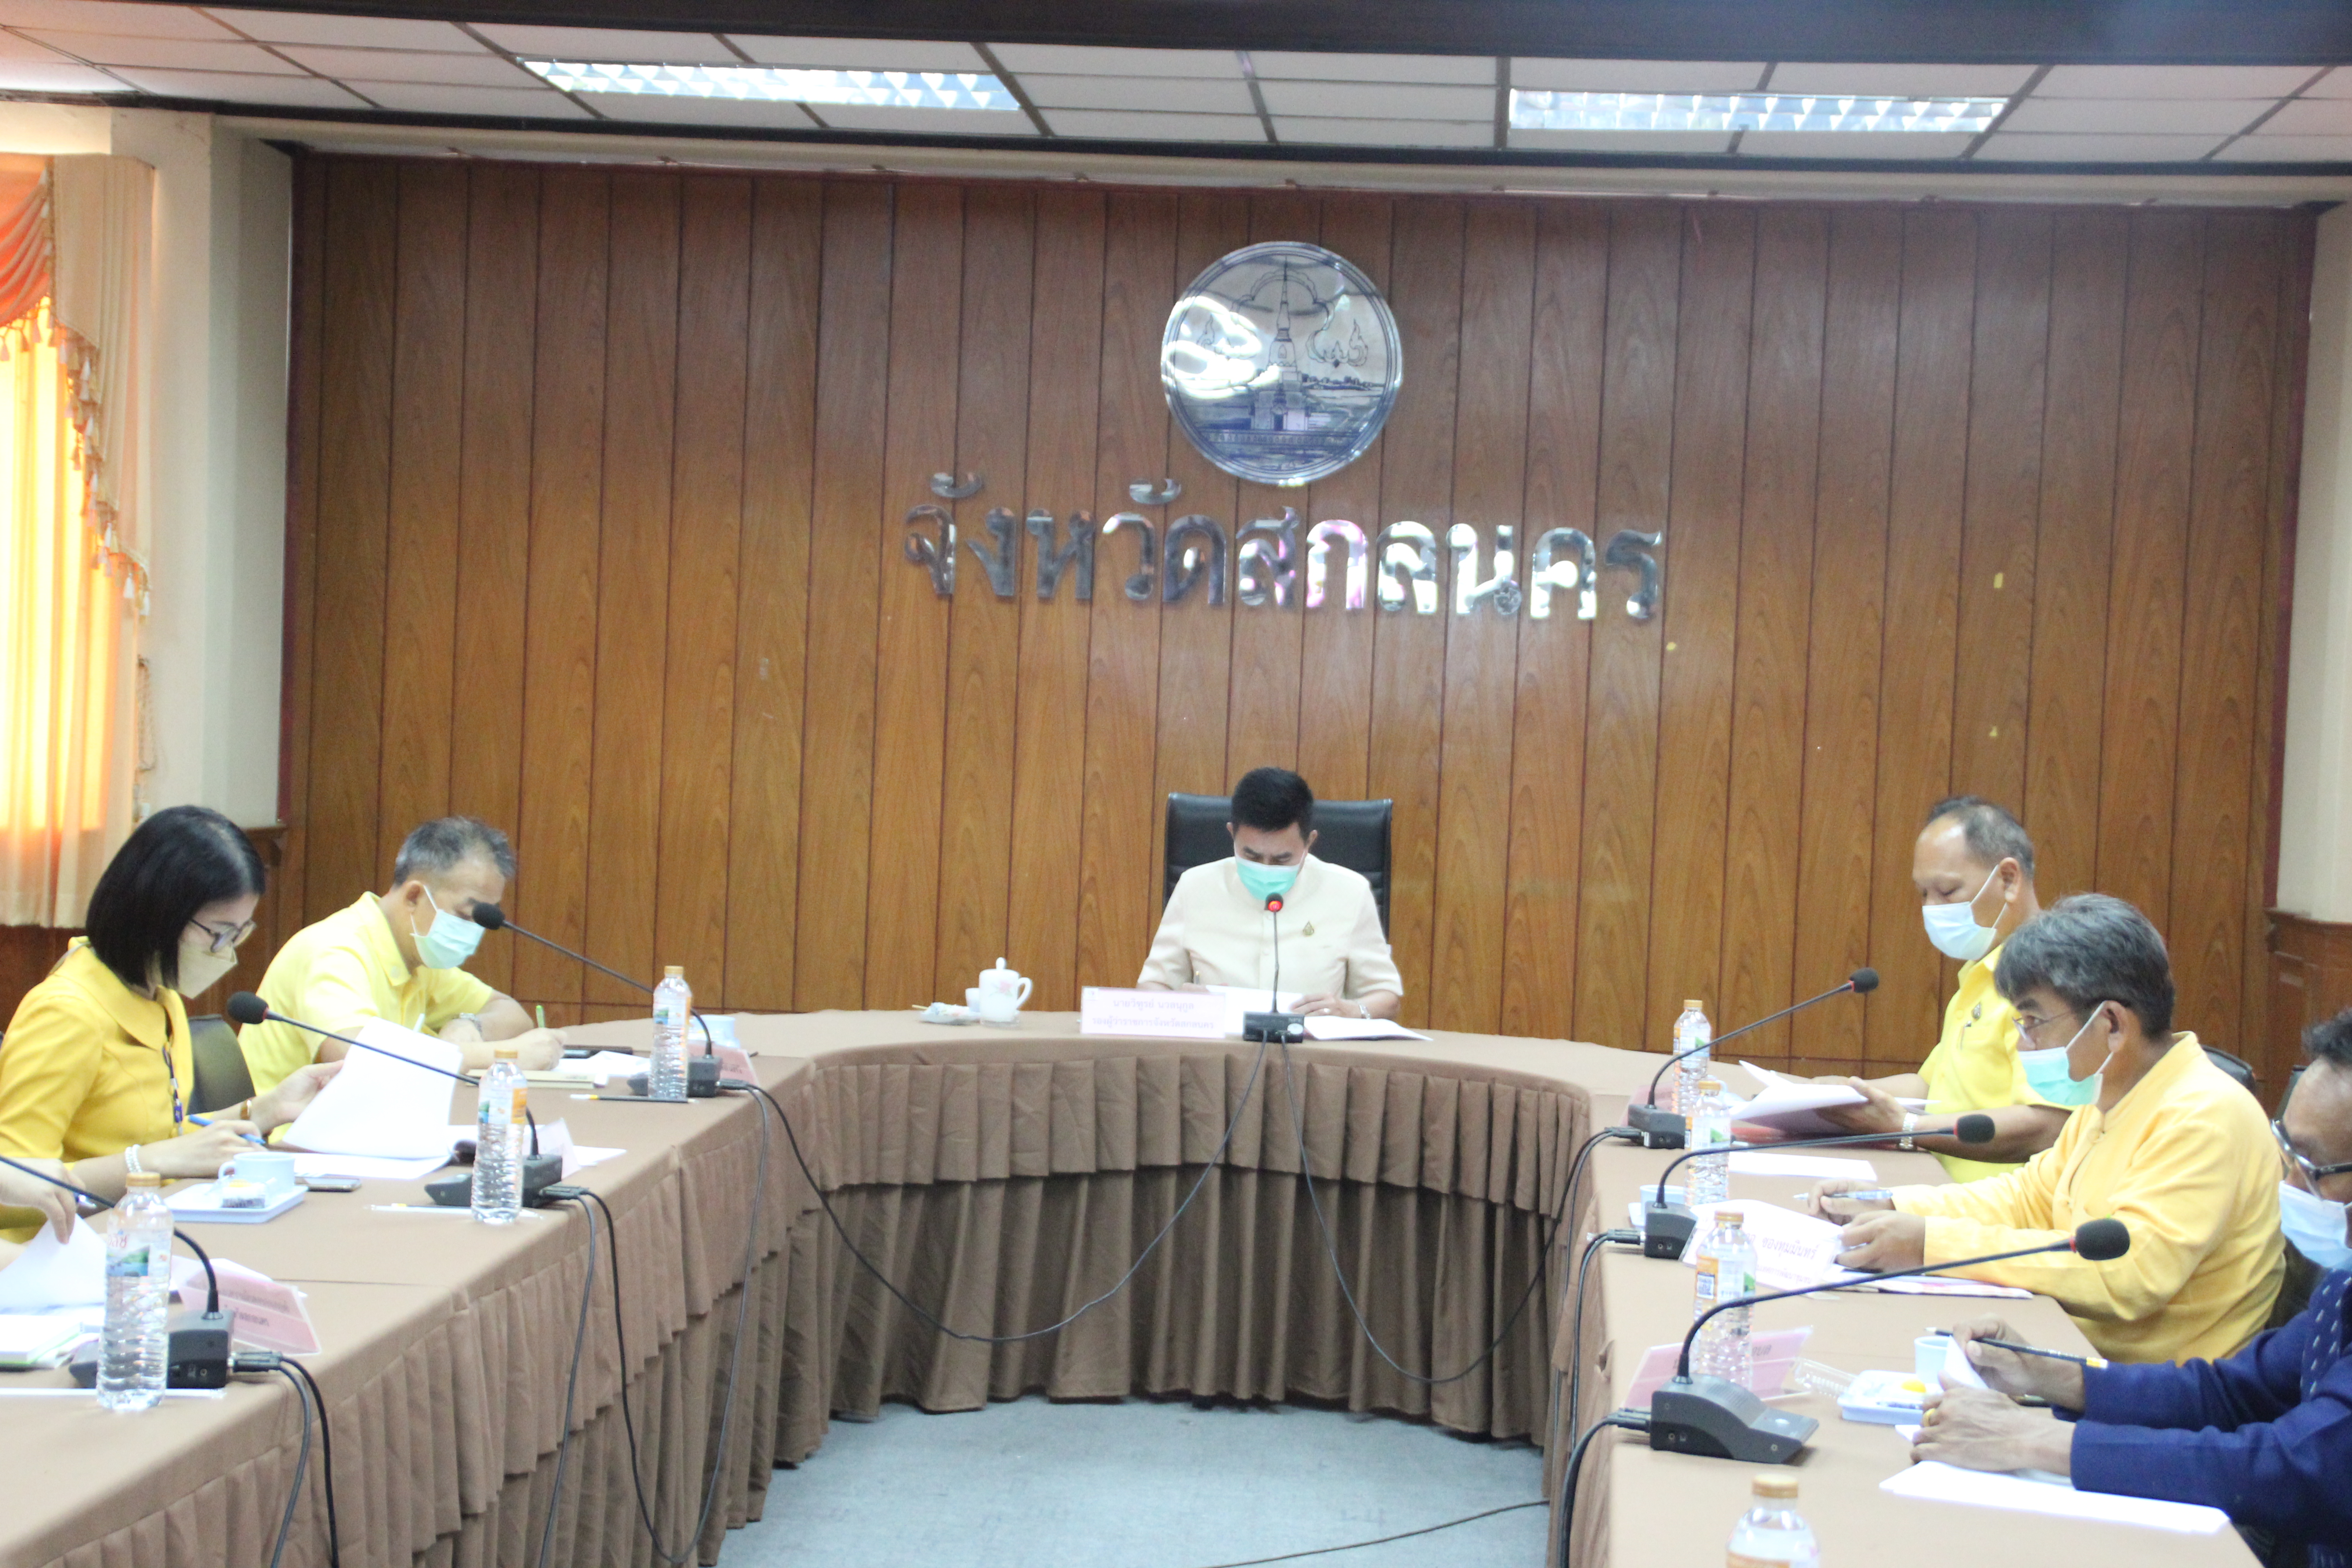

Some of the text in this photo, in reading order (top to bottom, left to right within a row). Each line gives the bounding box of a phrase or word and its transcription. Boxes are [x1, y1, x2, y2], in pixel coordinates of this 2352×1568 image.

[904, 472, 1663, 619] จังหวัดสกลนคร
